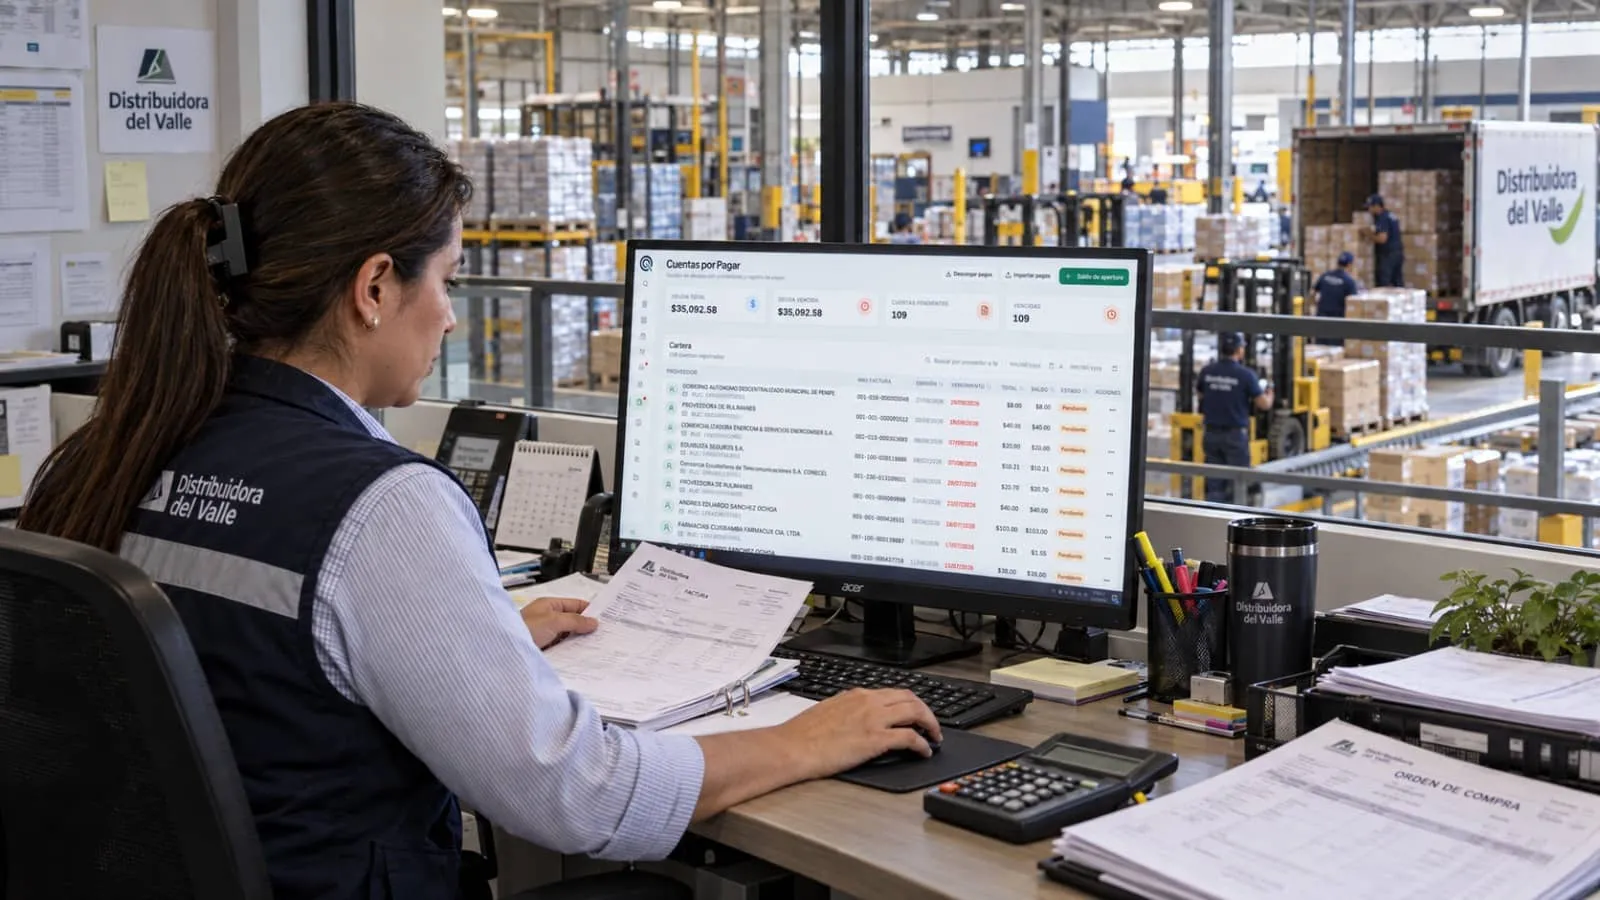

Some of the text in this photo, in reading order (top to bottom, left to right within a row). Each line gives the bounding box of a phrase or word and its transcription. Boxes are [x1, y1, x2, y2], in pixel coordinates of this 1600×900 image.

[109, 91, 209, 109] Distribuidora
[126, 113, 192, 130] del Valle
[1497, 164, 1576, 194] Distribuidora
[1507, 197, 1563, 226] del Valle
[666, 259, 741, 272] Cuentas por Pagar
[671, 304, 717, 314] $35,092.58
[778, 308, 822, 318] $35,092.58
[892, 311, 907, 320] 109
[1013, 314, 1030, 323] 109
[669, 341, 692, 350] Cartera
[176, 473, 264, 504] Distribuidora
[169, 496, 237, 525] del Valle
[679, 499, 701, 507] ANDRES
[730, 503, 756, 512] SANCHEZ
[757, 505, 778, 513] OCHOA
[841, 583, 864, 592] acer
[684, 588, 709, 600] FACTURA
[1236, 601, 1292, 613] Distribuidora
[1243, 614, 1284, 624] del Valle
[1394, 769, 1521, 812] ORDEN DE COMPRA
